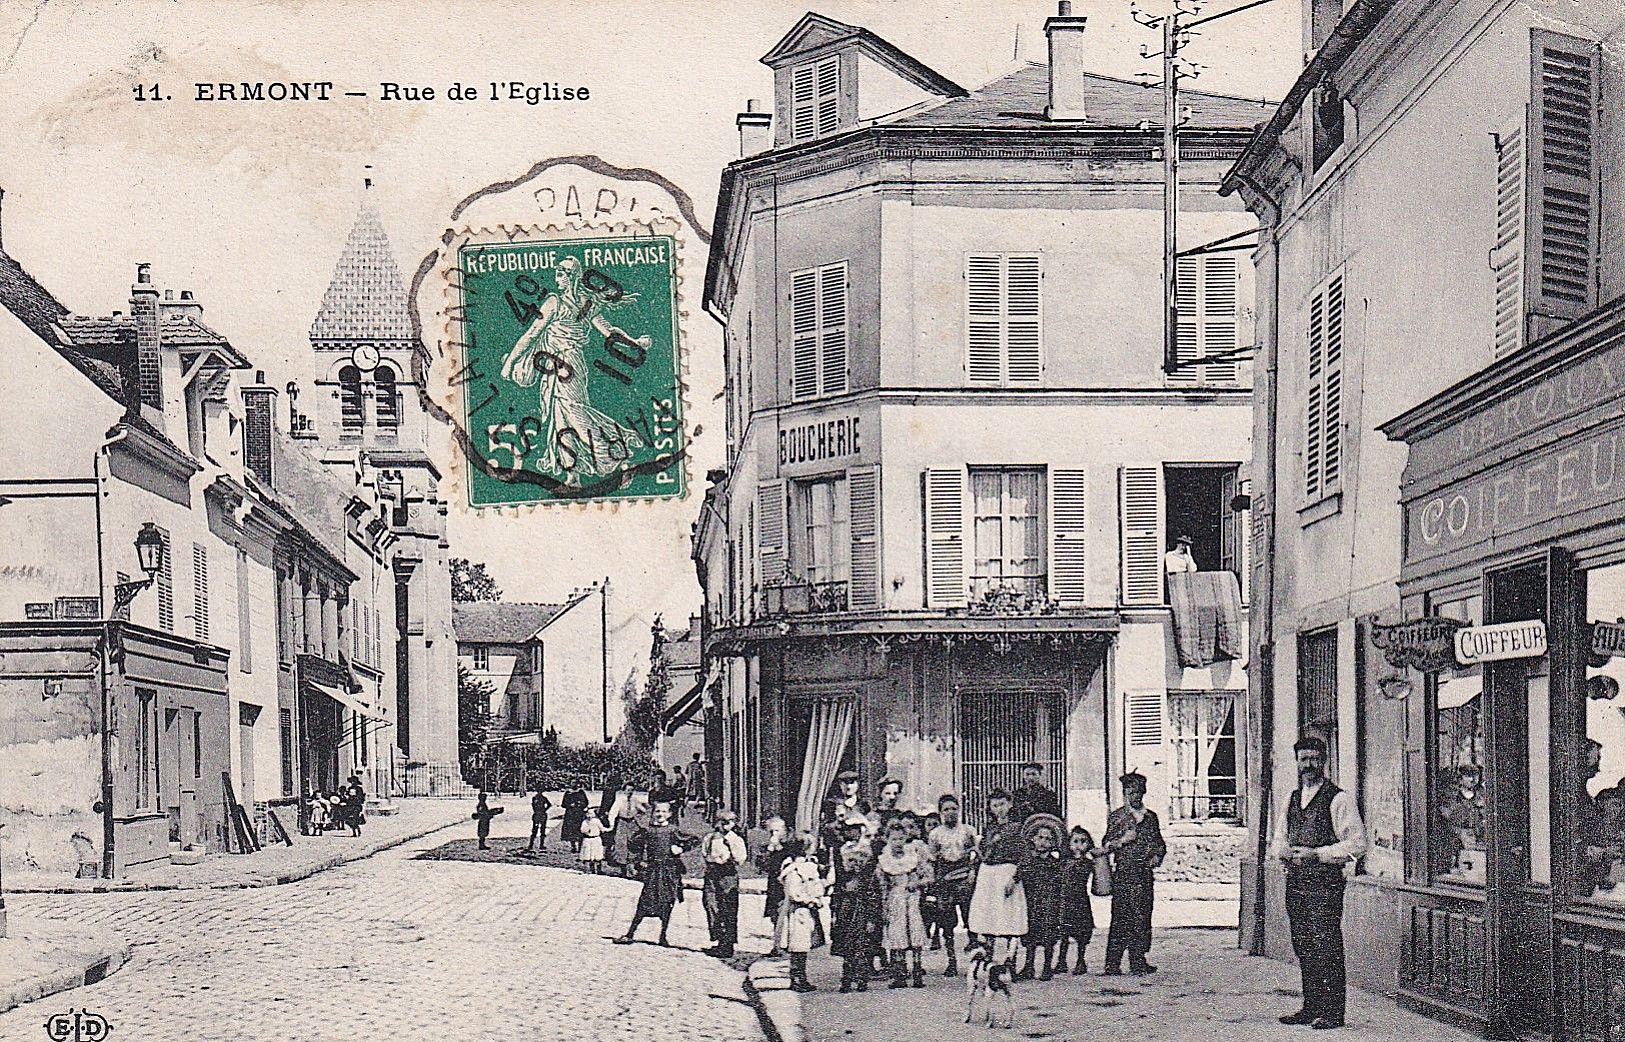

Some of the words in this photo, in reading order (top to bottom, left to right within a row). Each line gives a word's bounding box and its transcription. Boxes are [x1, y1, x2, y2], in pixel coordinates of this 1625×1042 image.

[584, 245, 666, 268] FRANÇAISE
[653, 398, 675, 484] POSTES
[779, 415, 861, 466] BOUCHERIE
[1460, 625, 1545, 660] COIFFEUR
